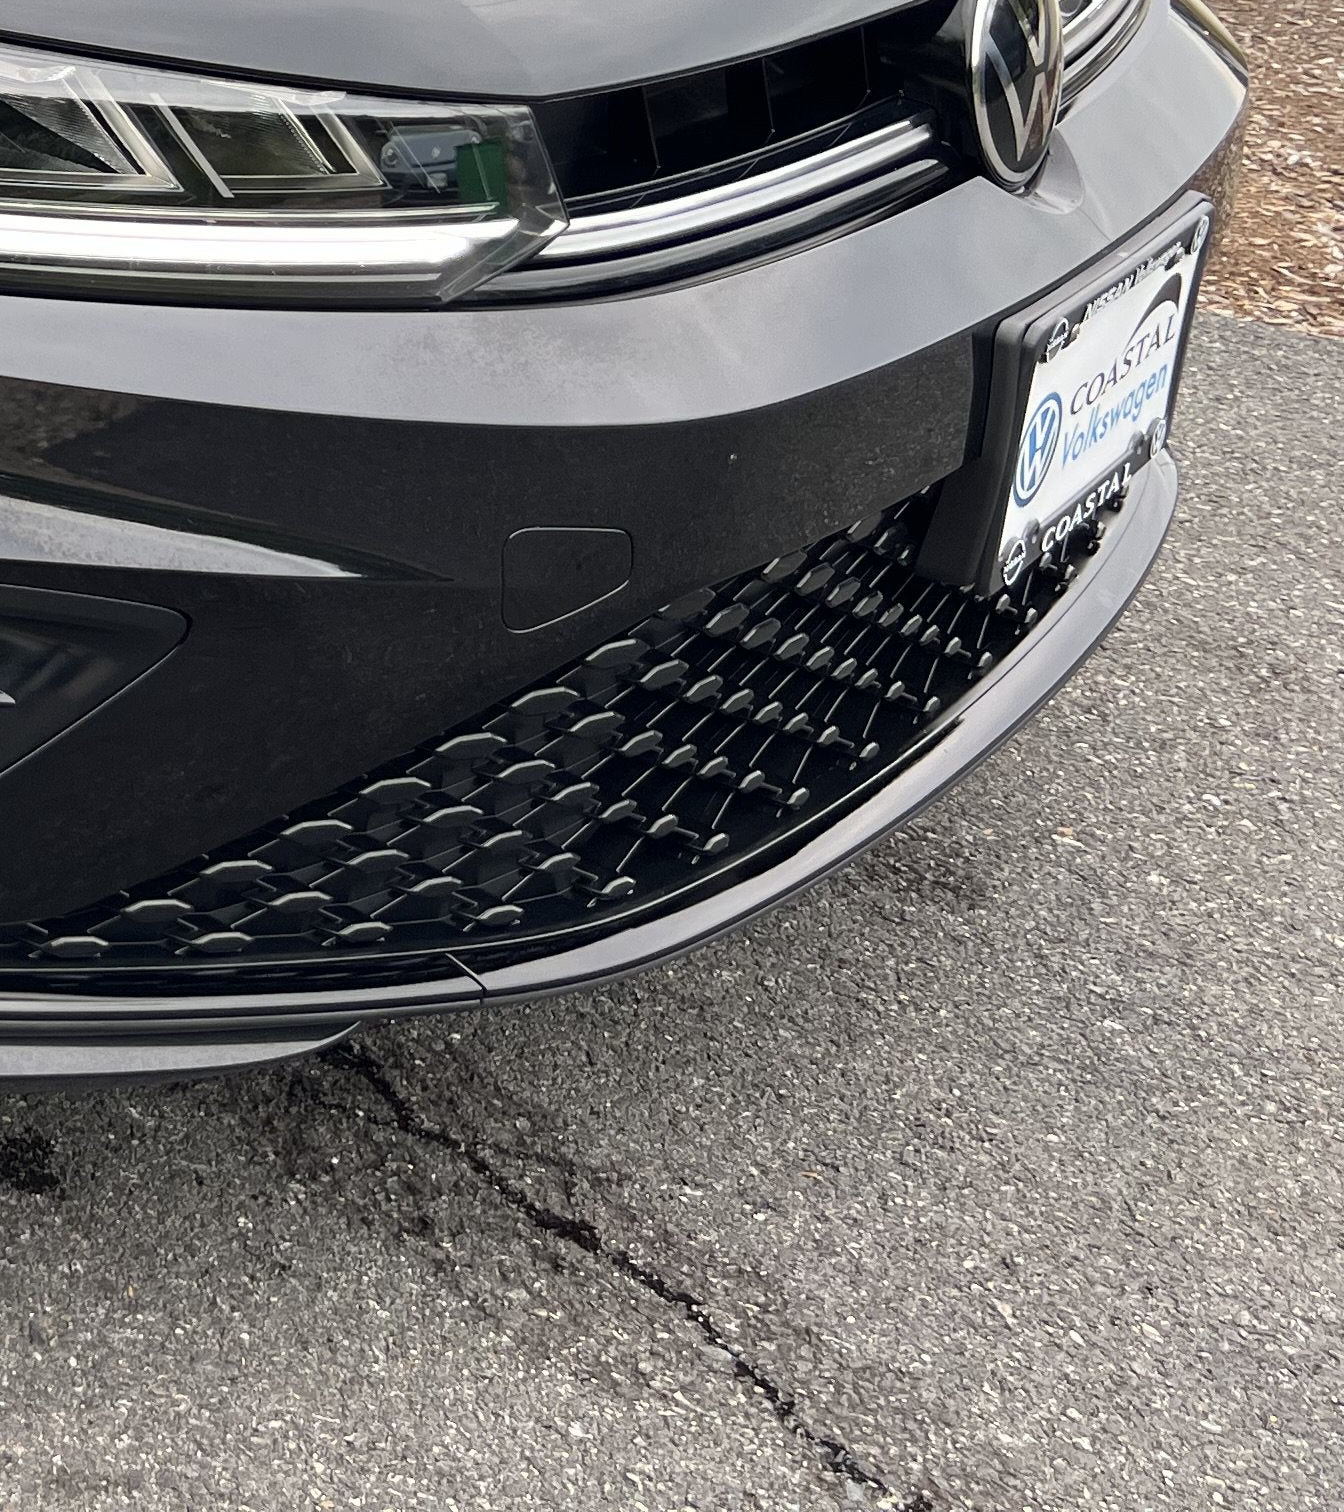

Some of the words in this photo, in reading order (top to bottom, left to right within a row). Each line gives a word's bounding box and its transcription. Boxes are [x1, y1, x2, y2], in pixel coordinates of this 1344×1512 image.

[1070, 314, 1177, 415] COASTAL
[1062, 363, 1168, 470] Volkswagen
[1042, 462, 1132, 552] COASTAL
